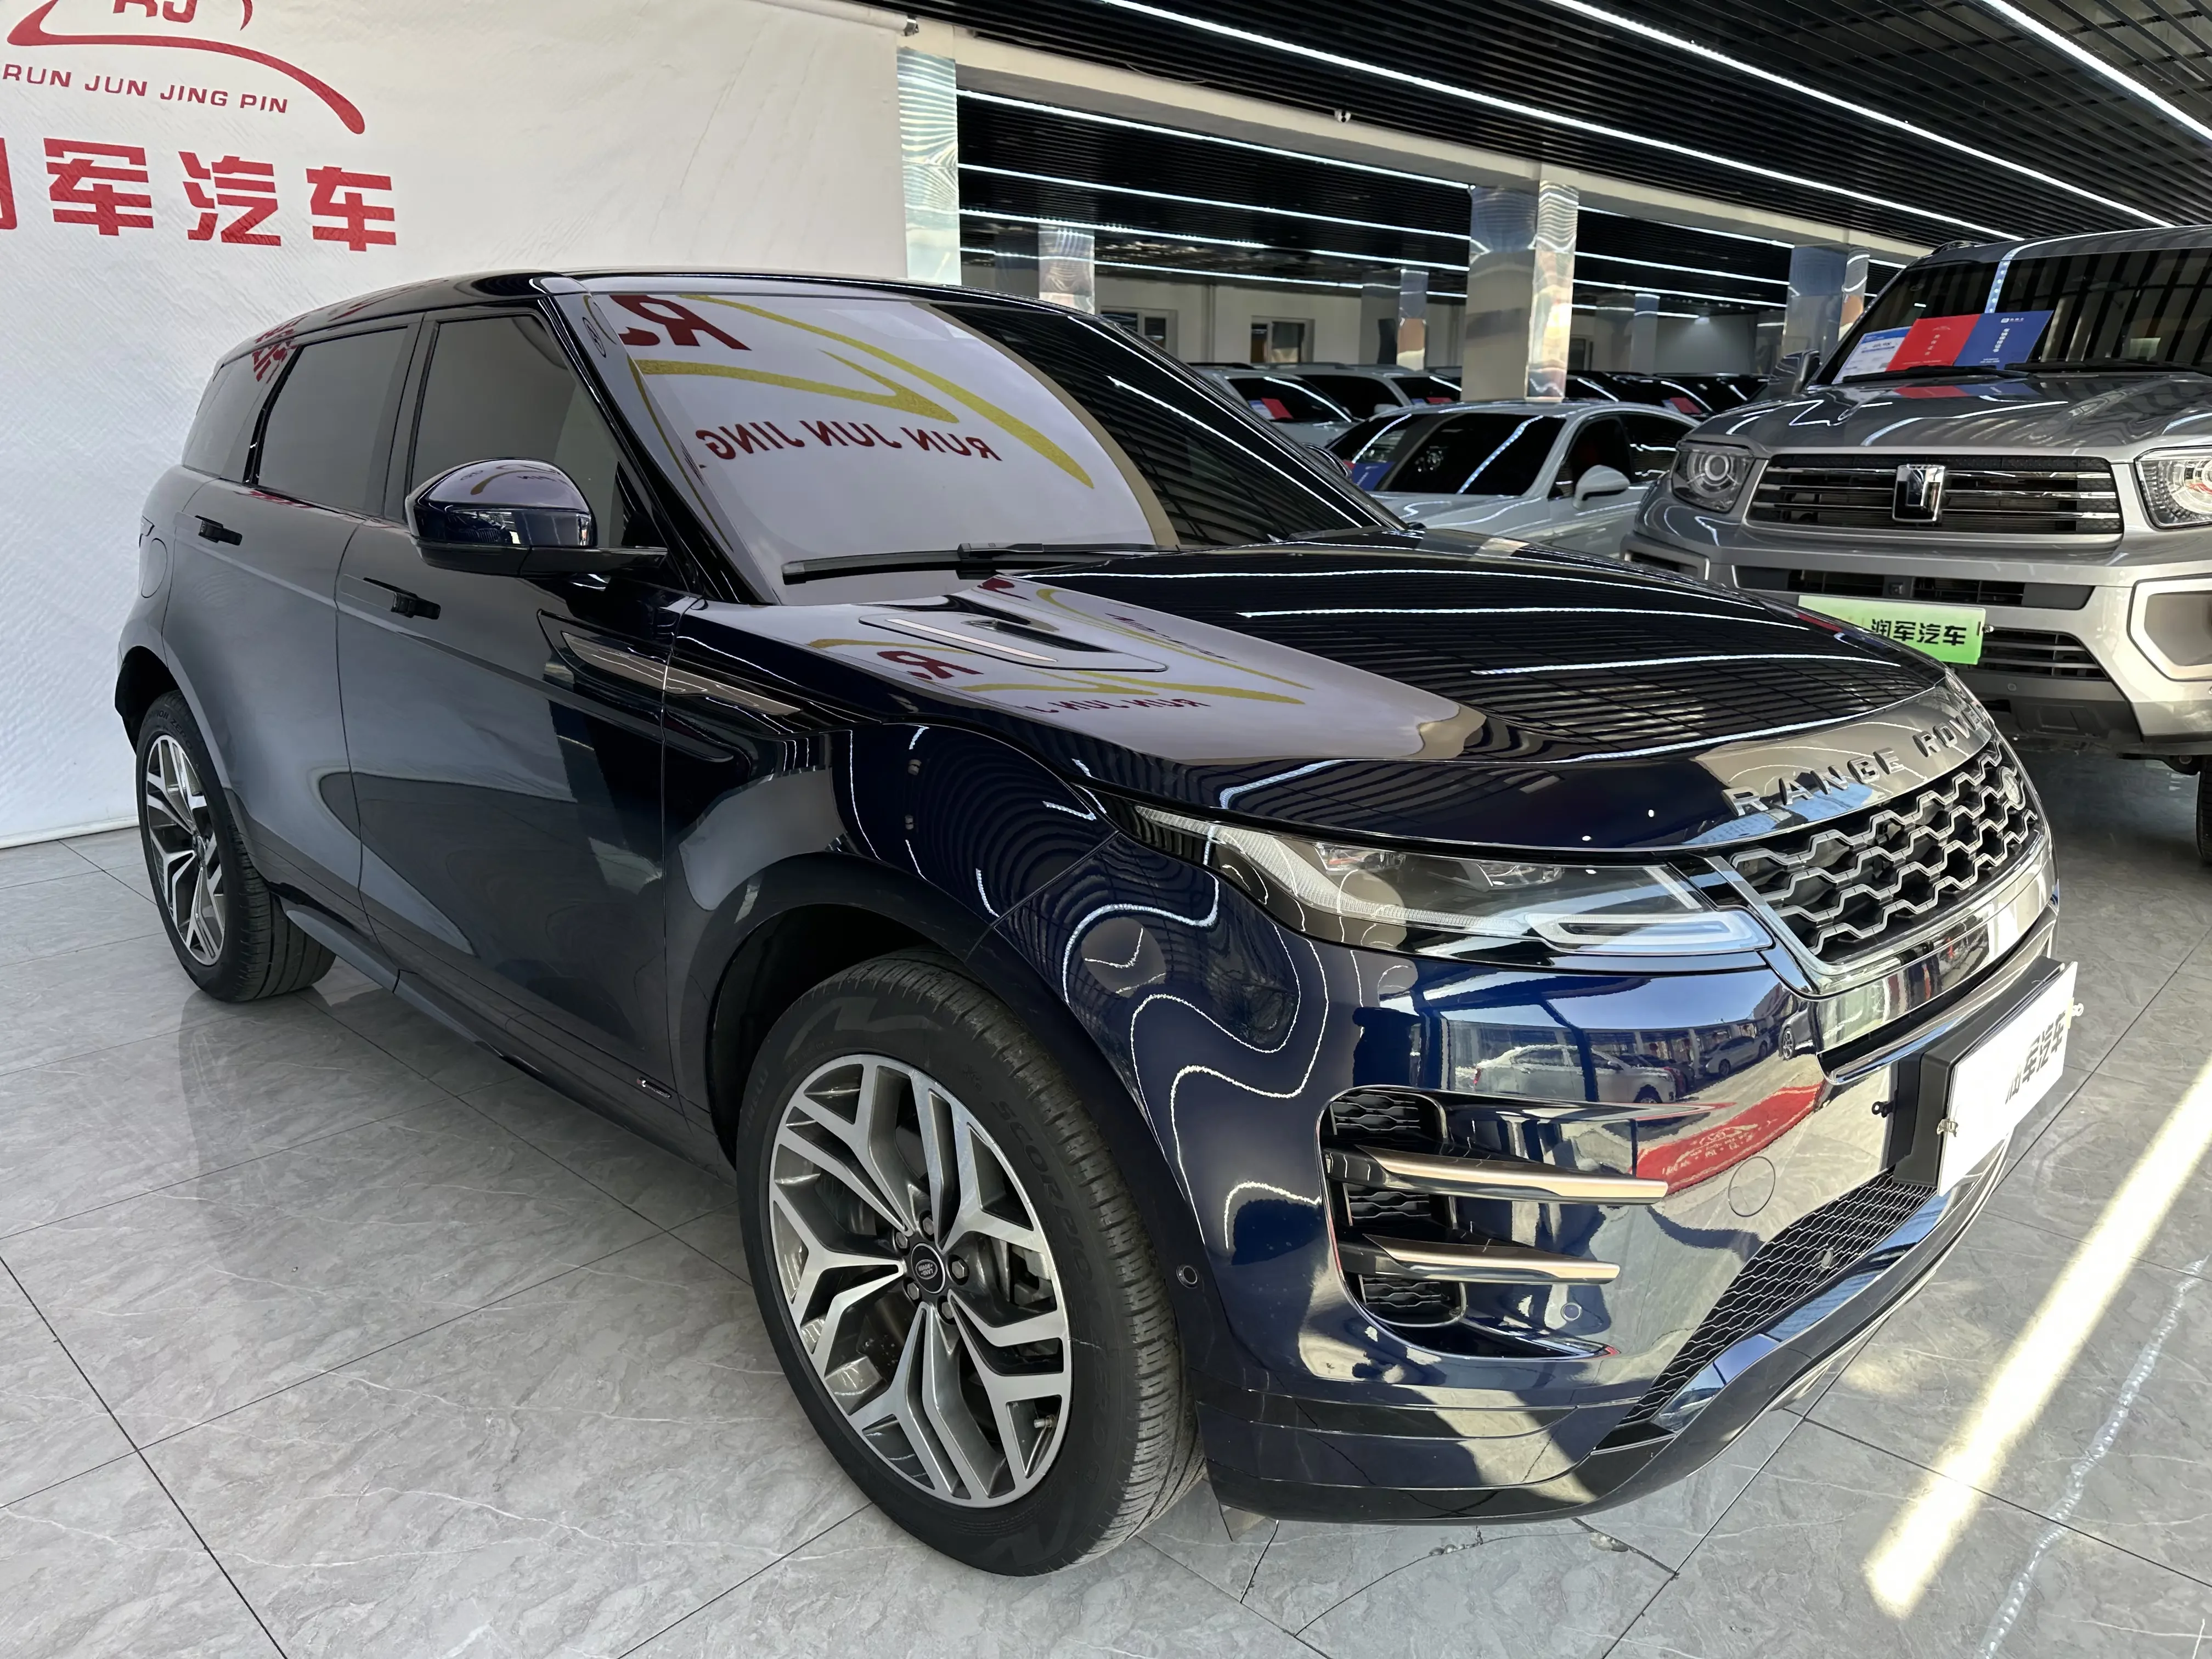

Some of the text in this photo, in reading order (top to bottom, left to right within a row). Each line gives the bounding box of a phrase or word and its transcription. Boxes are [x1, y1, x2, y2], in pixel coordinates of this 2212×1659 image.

[2, 64, 288, 113] RUN JUN JING PIN
[0, 137, 396, 252] 军汽车
[1721, 747, 1904, 816] RANGE
